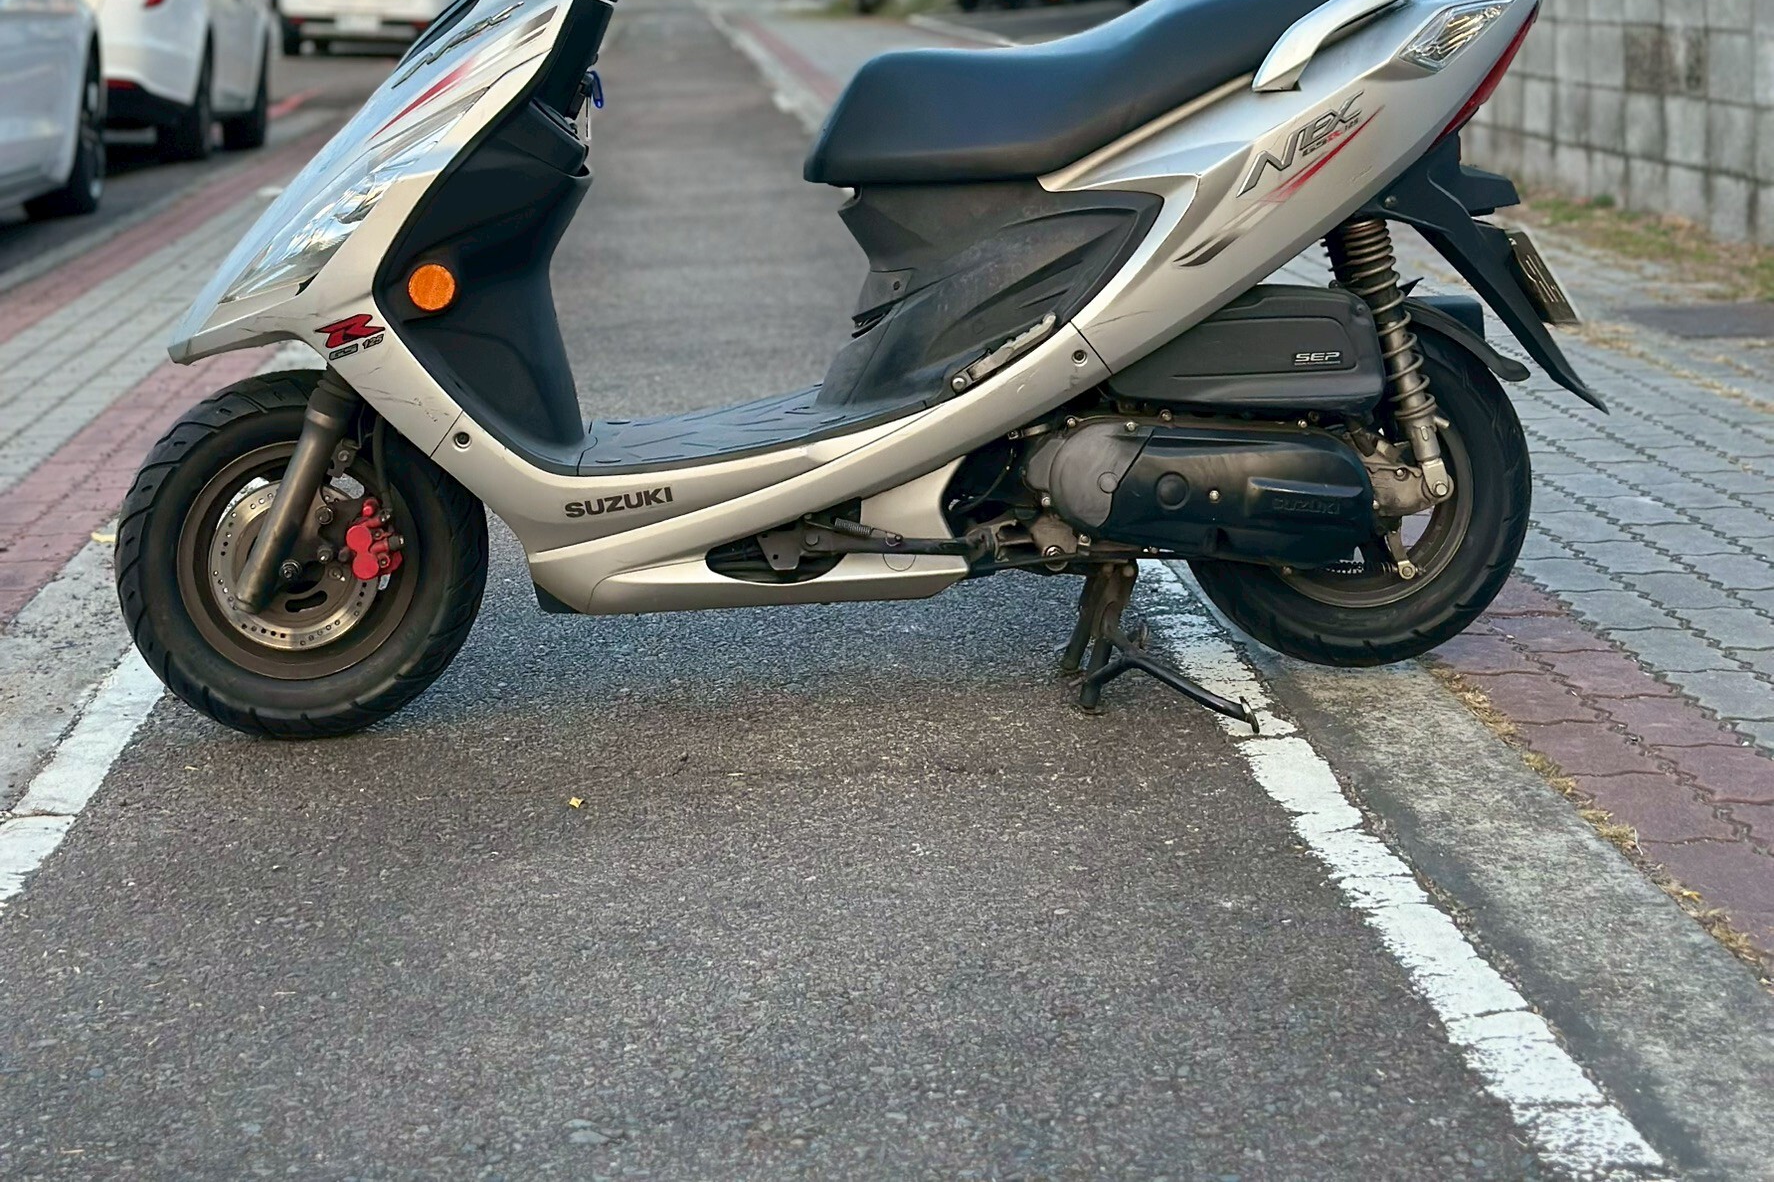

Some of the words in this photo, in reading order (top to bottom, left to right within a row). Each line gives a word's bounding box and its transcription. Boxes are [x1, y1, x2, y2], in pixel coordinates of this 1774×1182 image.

[362, 333, 385, 349] 125
[1295, 351, 1341, 362] SEP
[564, 486, 674, 518] SUZUKI
